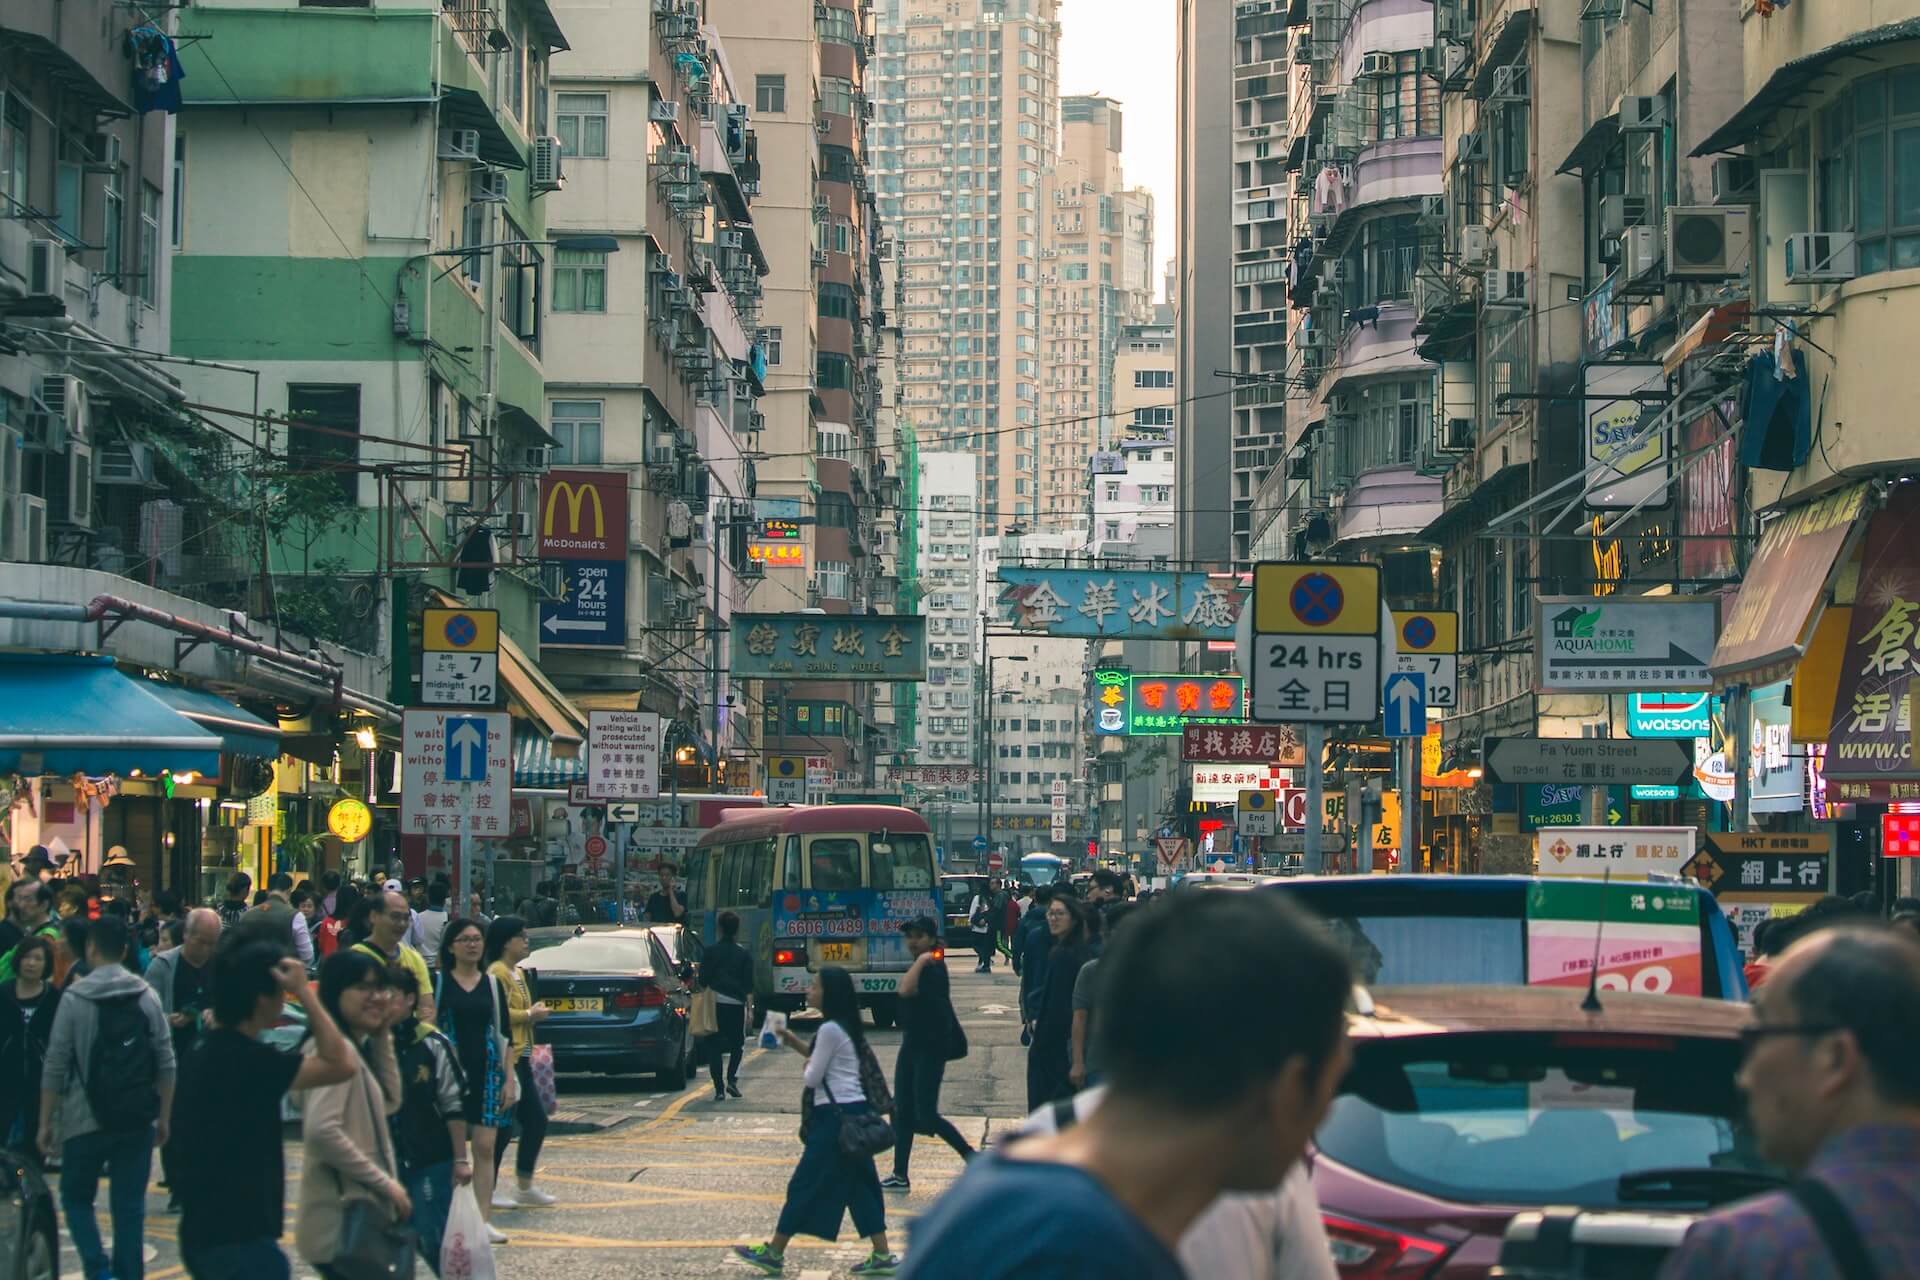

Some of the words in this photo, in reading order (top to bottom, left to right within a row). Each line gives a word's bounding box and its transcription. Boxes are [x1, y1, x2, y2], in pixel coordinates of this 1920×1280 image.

[544, 538, 607, 550] McDonald's
[578, 567, 608, 578] open
[578, 578, 607, 600] 24
[578, 600, 606, 610] hours
[1022, 578, 1237, 629] 金華冰廳
[1554, 639, 1635, 654] AQUAHOME
[1269, 644, 1309, 669] 24
[1318, 646, 1362, 669] hrs
[436, 663, 457, 672] 上午
[470, 656, 482, 673] 7
[807, 661, 838, 673] SHING
[850, 661, 885, 673] HOTEL
[1429, 657, 1441, 674] 7
[425, 681, 465, 690] midnight
[470, 685, 491, 702] 12
[1278, 679, 1350, 711] 全日
[1429, 686, 1451, 703] 12
[610, 714, 638, 723] Vehicle
[1637, 717, 1710, 731] watsons
[415, 729, 444, 738] waiti
[488, 730, 501, 740] be
[596, 724, 625, 733] waiting
[627, 724, 640, 732] will
[602, 733, 646, 742] prosecuted
[1204, 730, 1277, 756] 找換店
[625, 743, 655, 752] warning
[1540, 744, 1556, 757] Fa
[1562, 744, 1592, 757] Yuen
[1597, 744, 1638, 757] Street
[602, 754, 645, 763] 停車等候
[602, 769, 646, 779] 會被檢控
[1562, 763, 1616, 778] 花園街
[596, 784, 650, 793] 而不予警告
[778, 780, 796, 788] End
[1636, 788, 1676, 798] watsons
[1248, 813, 1265, 821] End
[1528, 814, 1548, 823] Tel:
[1550, 814, 1573, 823] 2630
[1376, 825, 1392, 845] 店
[1742, 838, 1765, 848] HKT
[1576, 843, 1624, 858] 網上行
[1741, 860, 1821, 886] 網上行
[787, 920, 823, 936] 6606
[827, 919, 864, 934] 0489
[567, 999, 599, 1010] 3312
